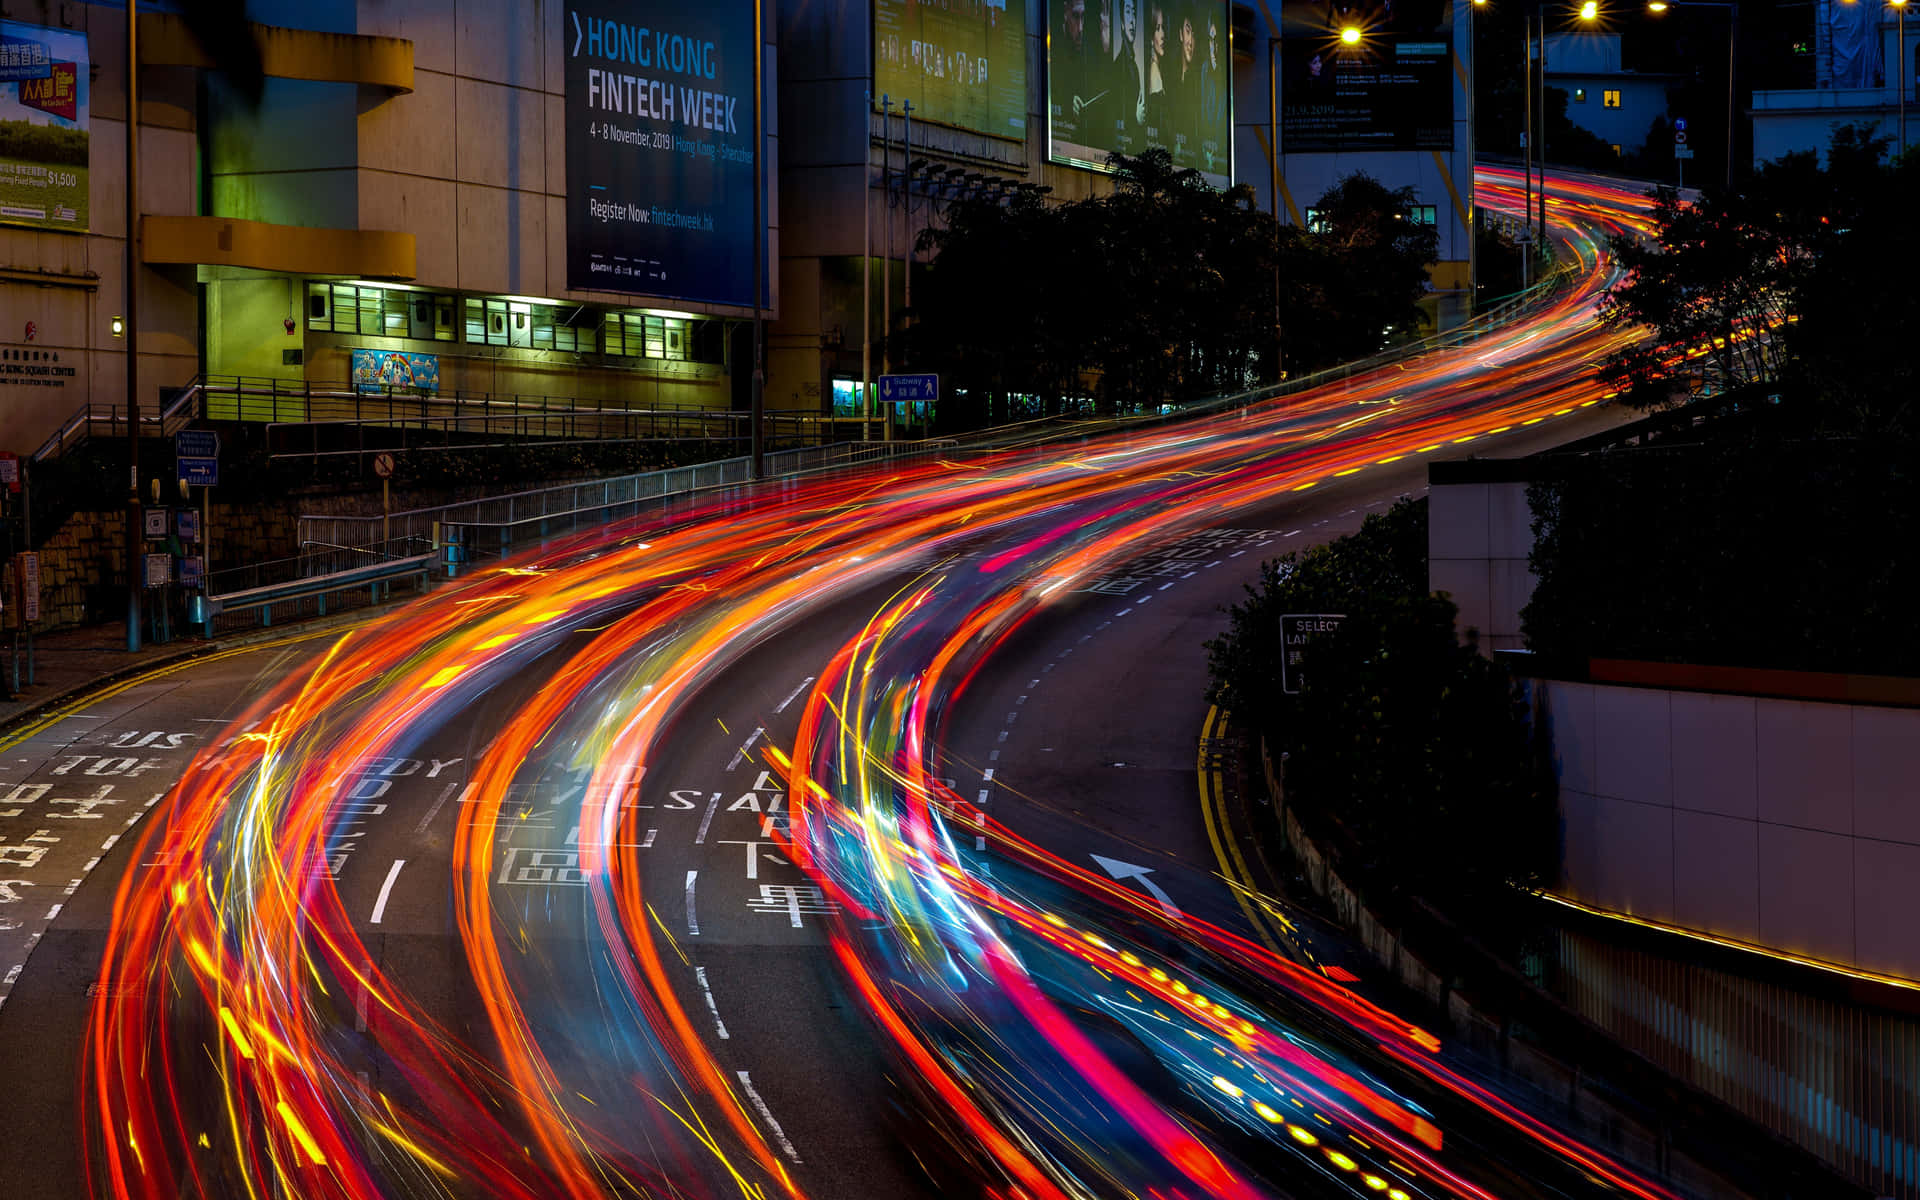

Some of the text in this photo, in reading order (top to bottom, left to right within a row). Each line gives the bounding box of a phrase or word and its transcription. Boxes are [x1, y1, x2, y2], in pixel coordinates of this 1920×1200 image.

[588, 17, 716, 79] HONG KONG
[588, 68, 737, 134] FINTECH WEEK
[590, 122, 596, 137] 4
[602, 125, 608, 139] 8
[48, 171, 77, 188] $1,500
[590, 199, 714, 232] Register Now: fintechweek.hk
[893, 378, 922, 387] Subway
[1296, 620, 1340, 632] SELECT
[1287, 634, 1310, 645] LAN
